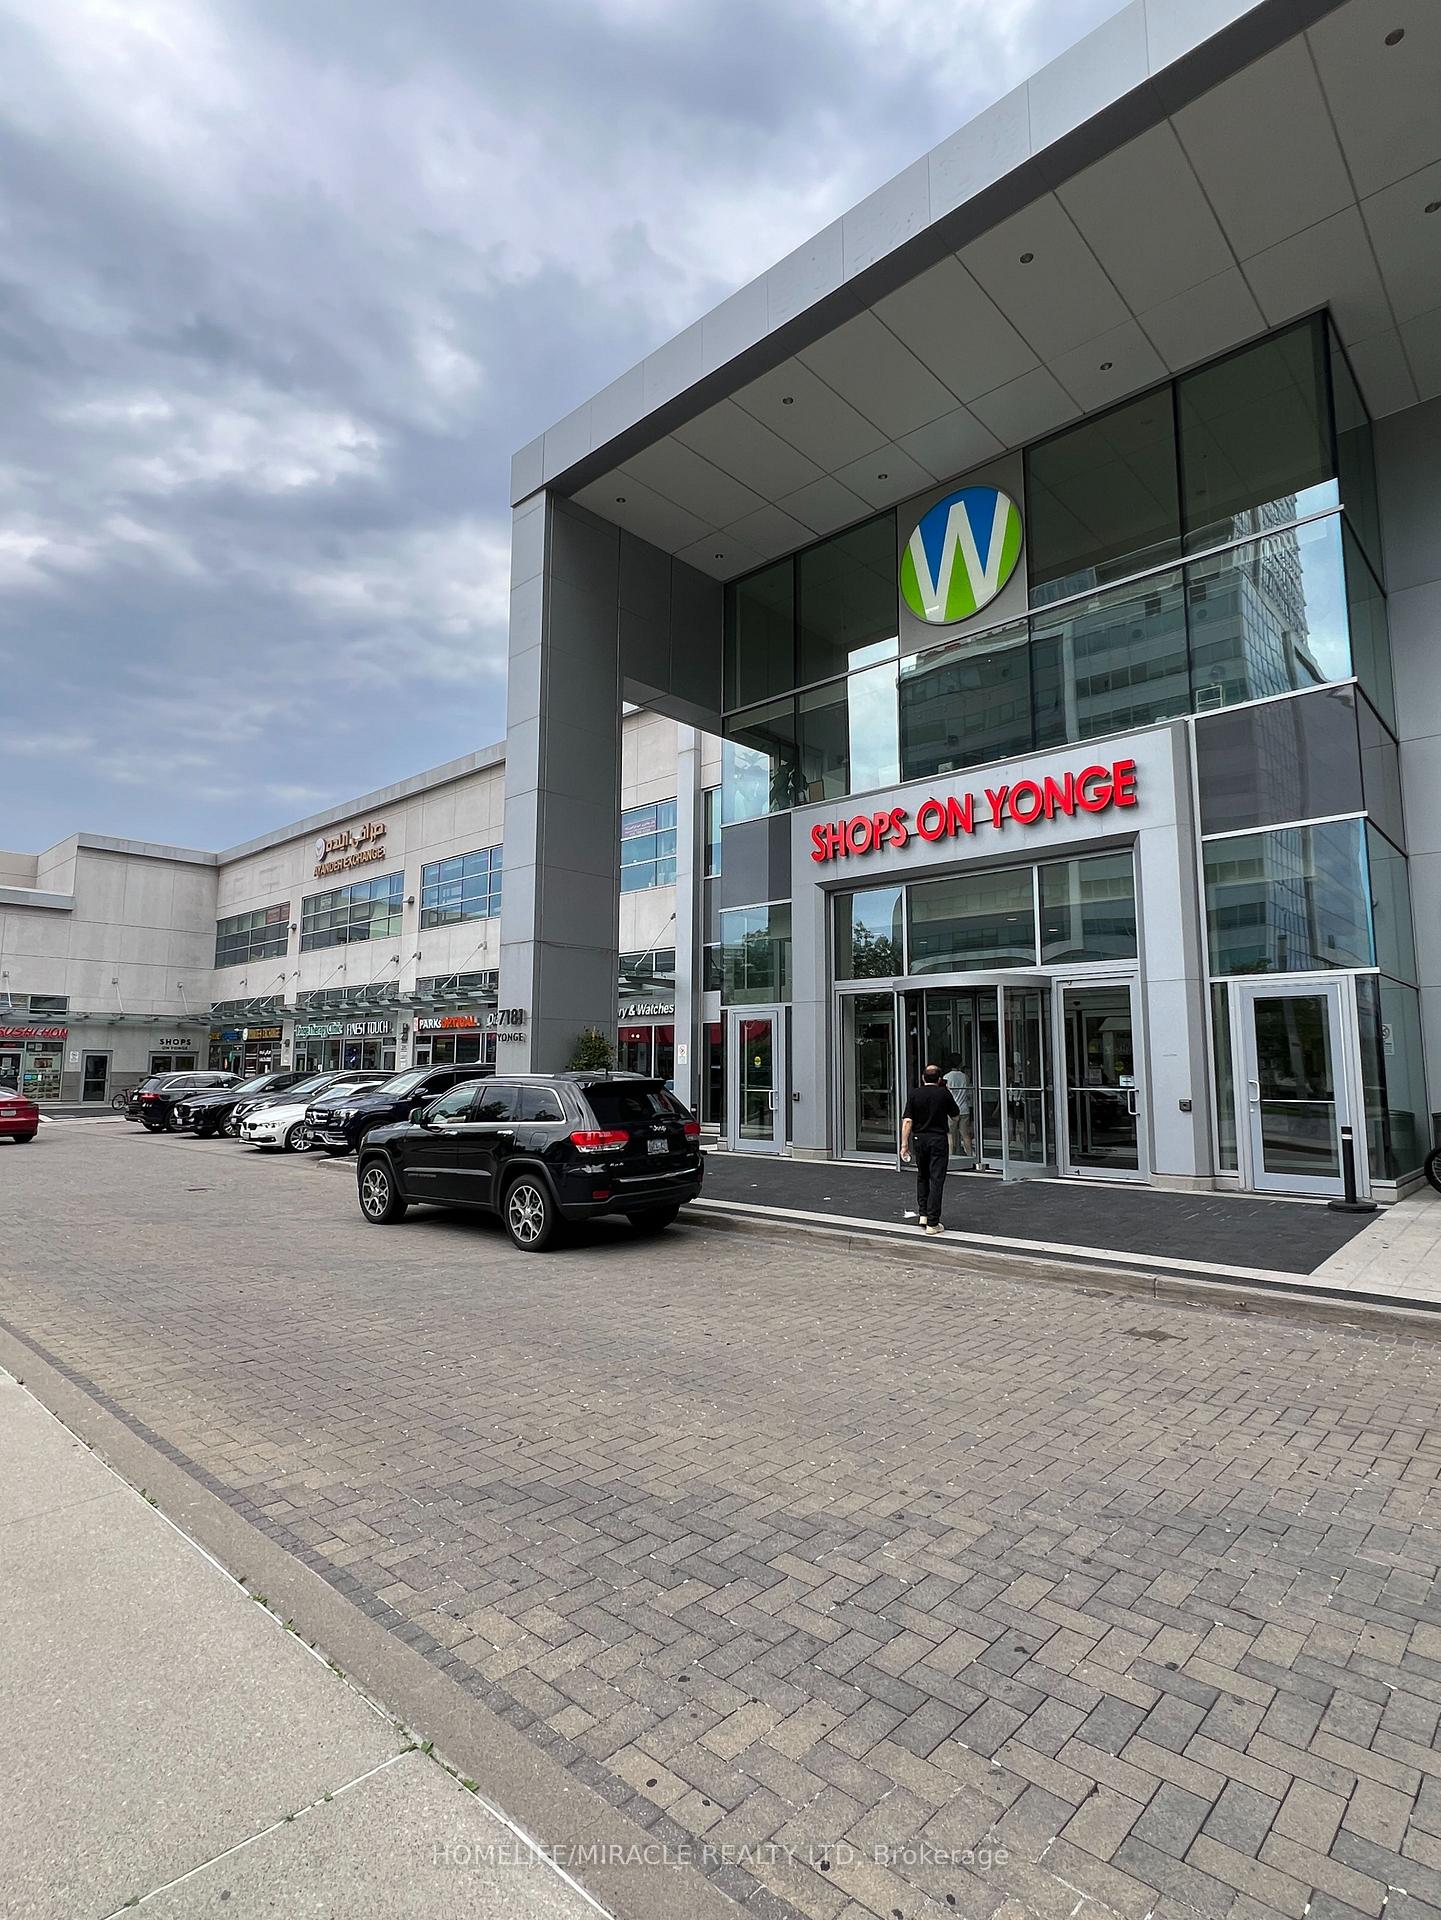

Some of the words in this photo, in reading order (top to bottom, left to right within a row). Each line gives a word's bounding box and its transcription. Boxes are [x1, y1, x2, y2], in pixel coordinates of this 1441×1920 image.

[810, 807, 908, 863] SHOPS
[916, 793, 974, 841] ON
[985, 759, 1137, 829] YONGE
[313, 858, 345, 878] AYANDEH
[344, 846, 386, 870] EXCHANGE
[628, 1004, 636, 1016] &
[637, 1002, 675, 1016] Watches
[498, 1008, 524, 1026] 7181
[367, 1020, 388, 1034] TOUCH
[159, 1038, 192, 1046] SHOPS
[497, 1032, 524, 1042] YONGE
